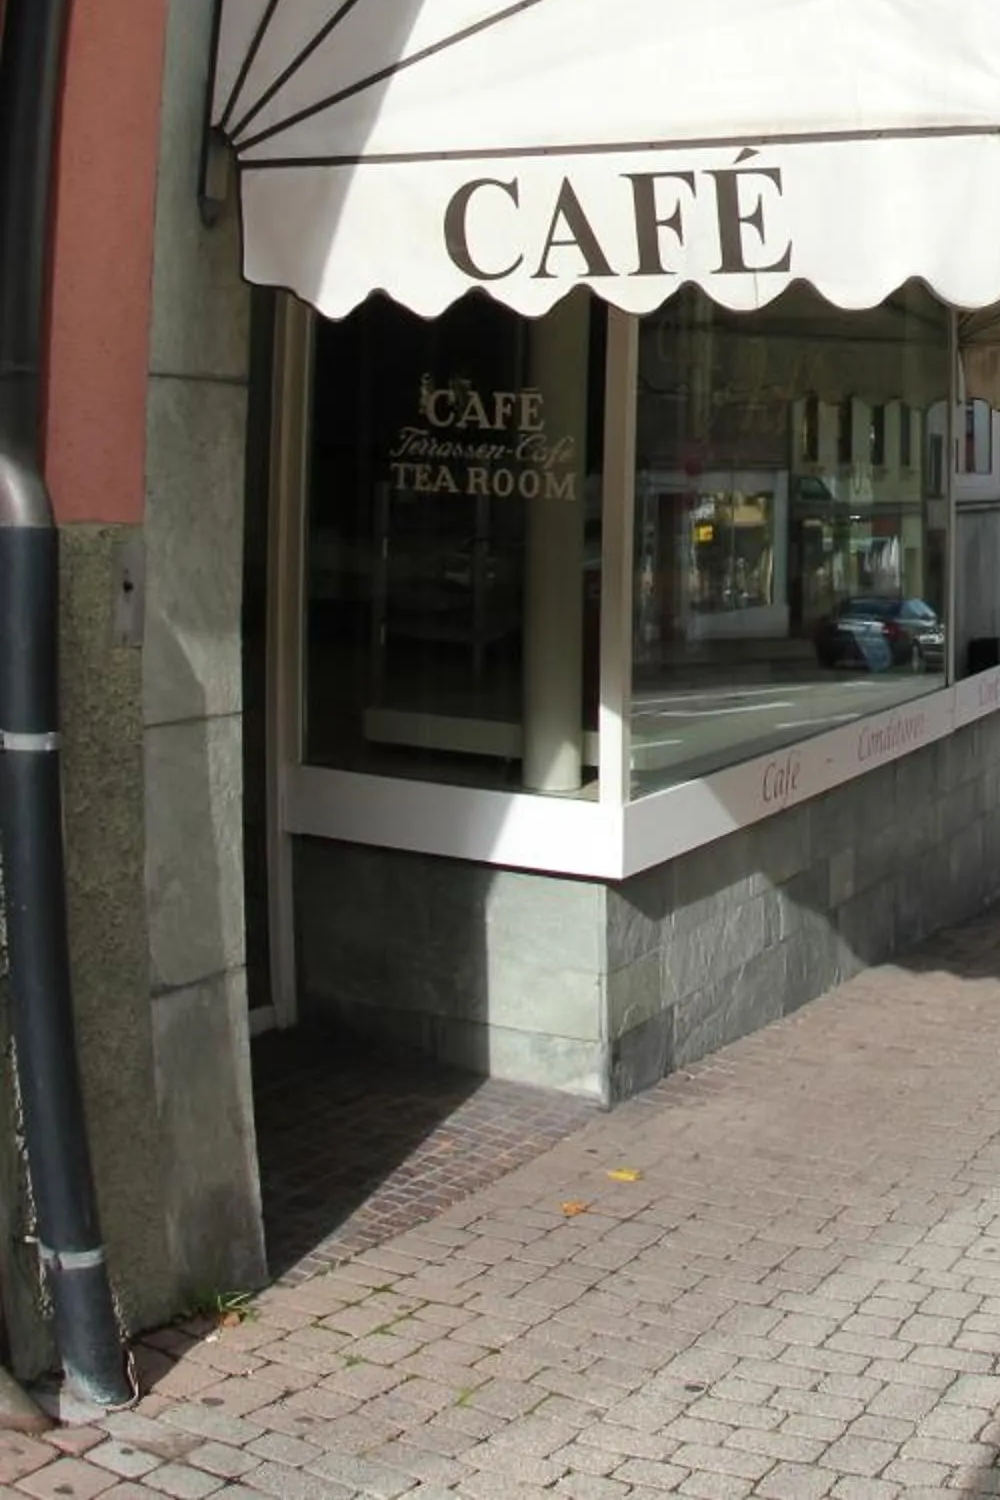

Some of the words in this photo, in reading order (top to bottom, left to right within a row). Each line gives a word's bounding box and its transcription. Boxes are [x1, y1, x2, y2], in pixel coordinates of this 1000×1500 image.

[442, 147, 794, 280] CAFÉ
[390, 462, 460, 494] TEA
[466, 465, 578, 501] ROOM
